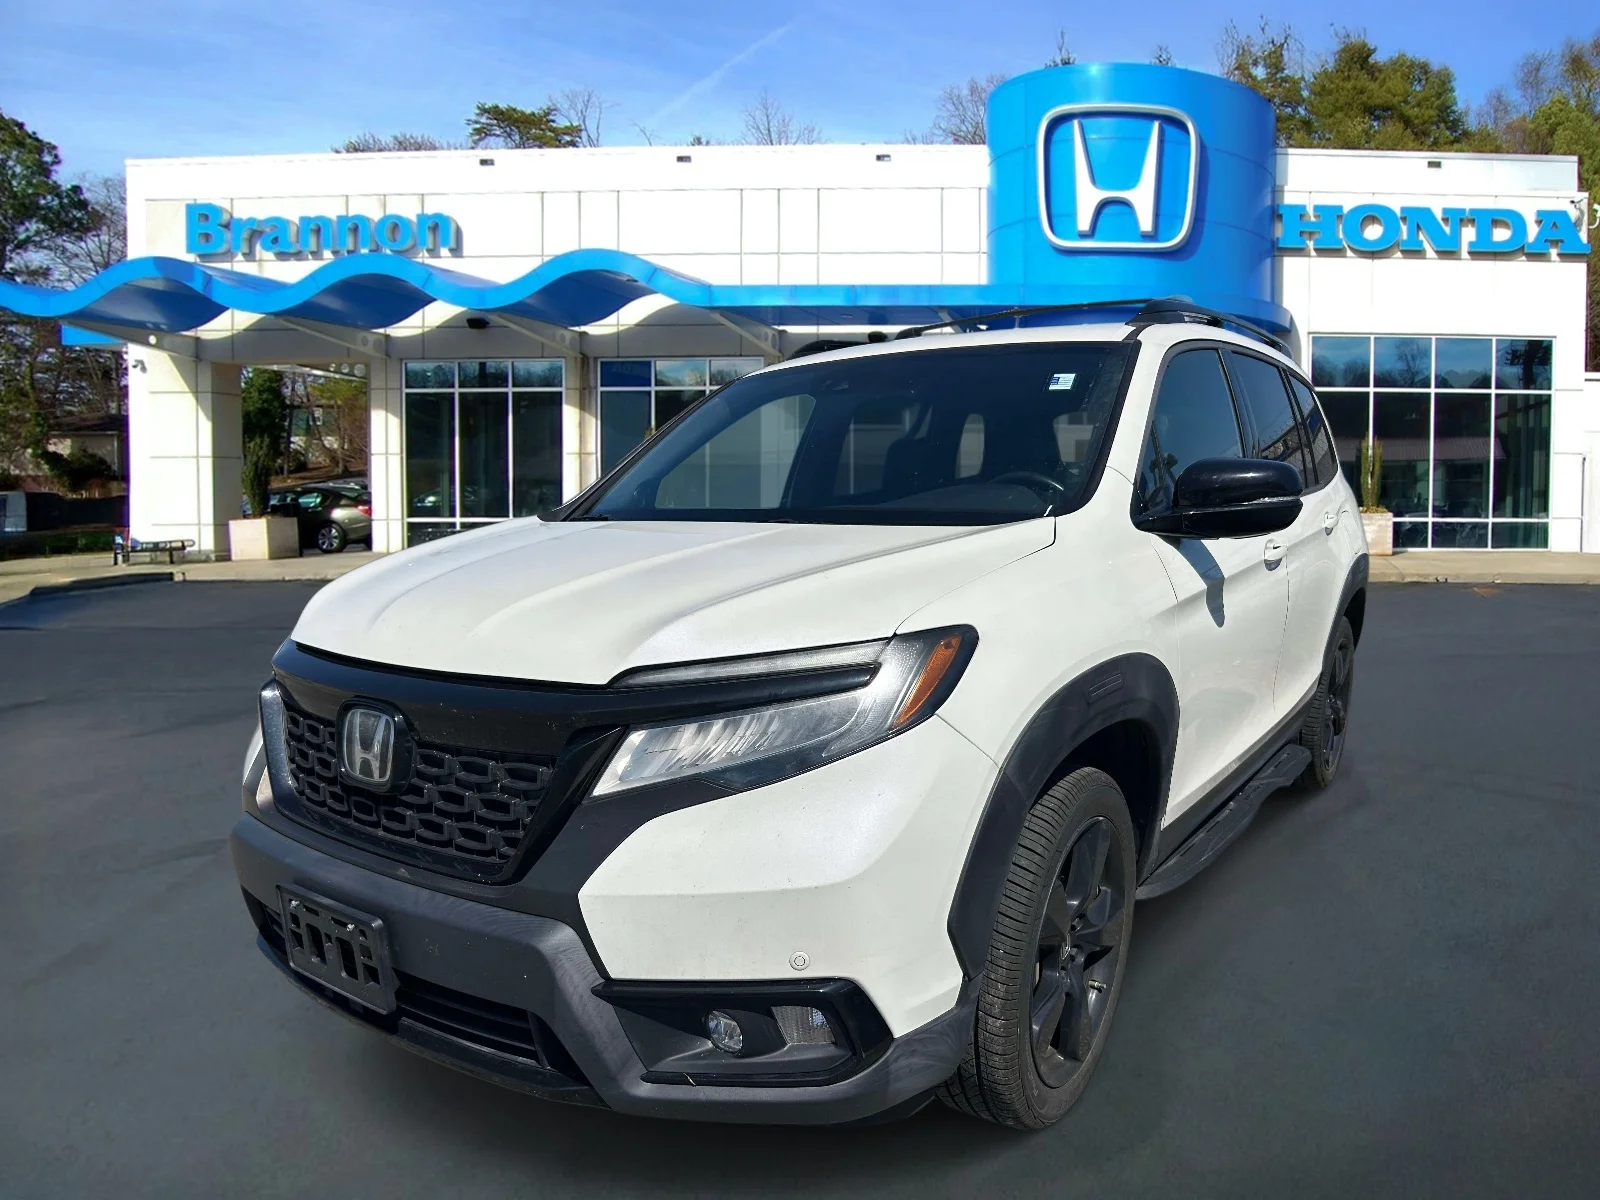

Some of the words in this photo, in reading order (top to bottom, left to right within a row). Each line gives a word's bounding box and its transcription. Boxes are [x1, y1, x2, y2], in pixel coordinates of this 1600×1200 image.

[1072, 118, 1160, 235] H
[185, 202, 460, 259] Brannon
[1277, 202, 1591, 254] HONDA
